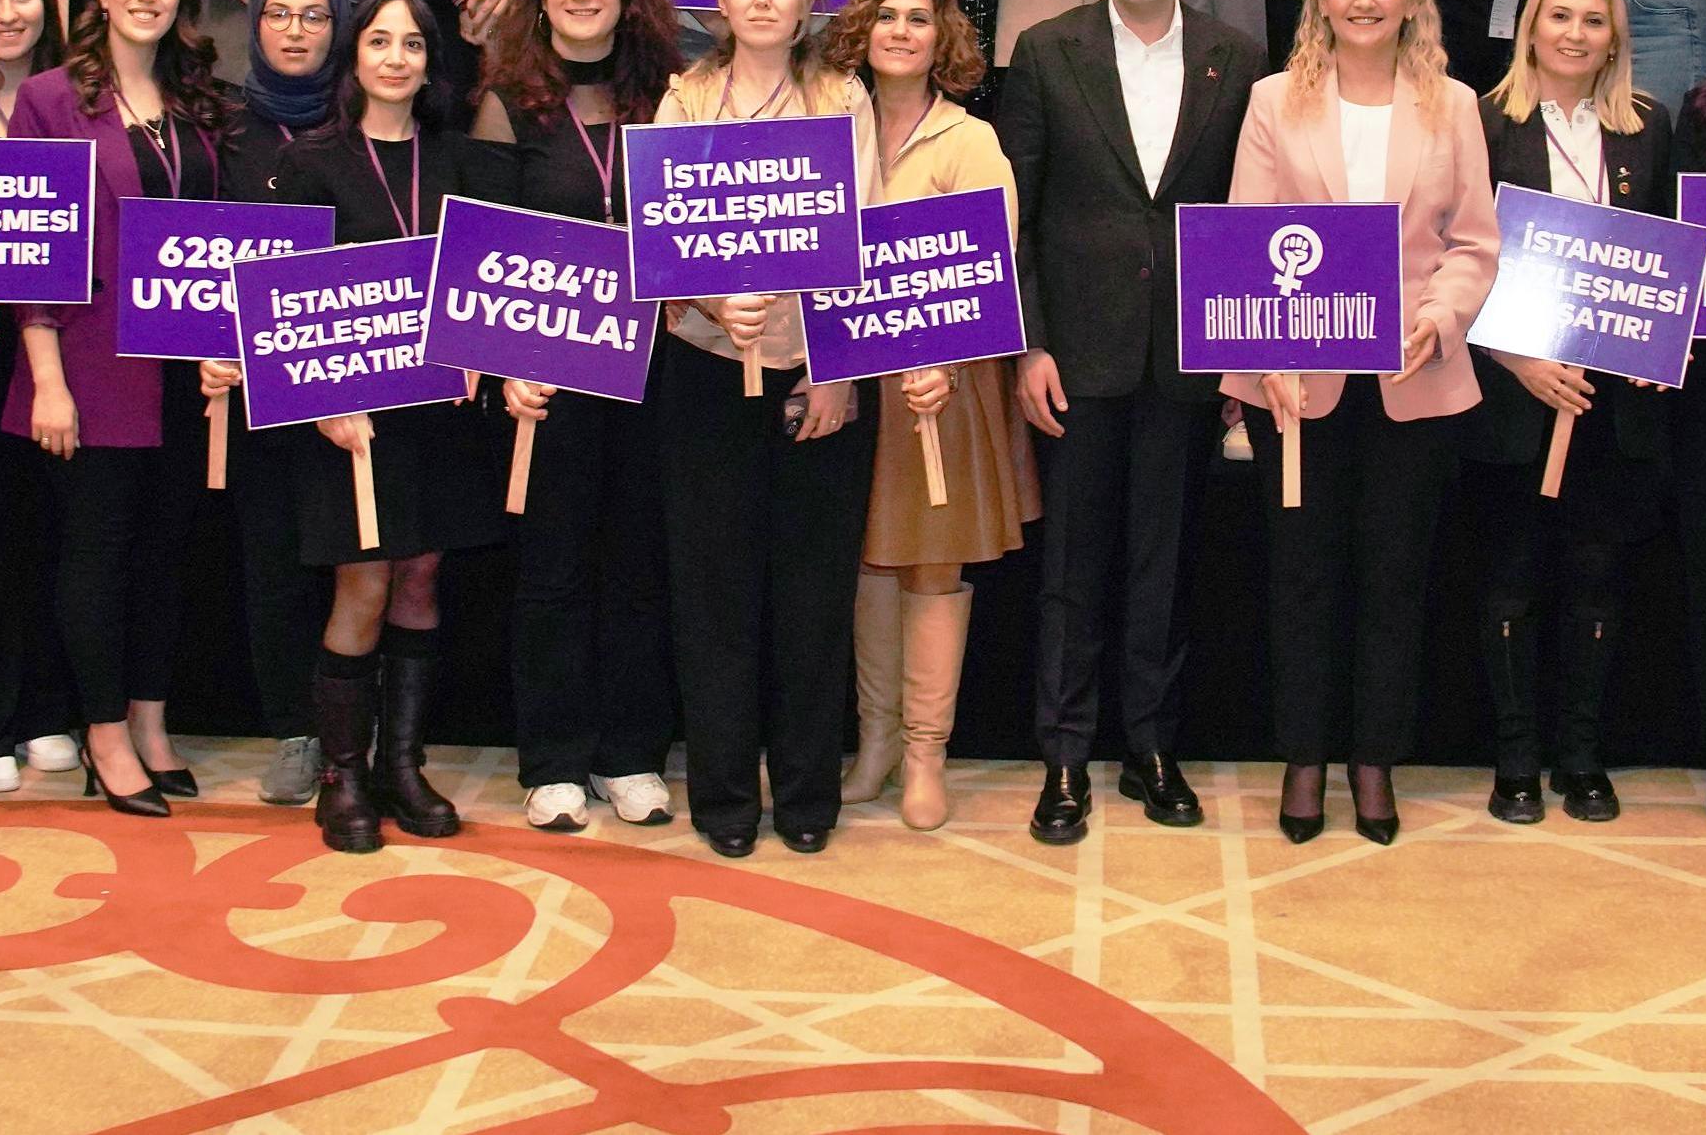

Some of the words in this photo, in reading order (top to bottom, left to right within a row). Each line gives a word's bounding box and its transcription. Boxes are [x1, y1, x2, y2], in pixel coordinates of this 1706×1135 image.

[662, 156, 822, 189] İSTANBUL
[642, 181, 846, 227] SÖZLEŞMESİ
[672, 226, 819, 261] YAŞATIR!
[859, 229, 980, 270] TANBUL
[1521, 221, 1671, 280] İSTANBUL
[270, 276, 424, 319] İSTANBUL
[477, 250, 619, 304] 6284'Ü
[446, 287, 639, 352] UYGULA!
[841, 296, 982, 340] YAŞATIR!
[1204, 294, 1283, 340] BİRLİKTE
[1287, 292, 1377, 348] GÜÇLÜYÜZ
